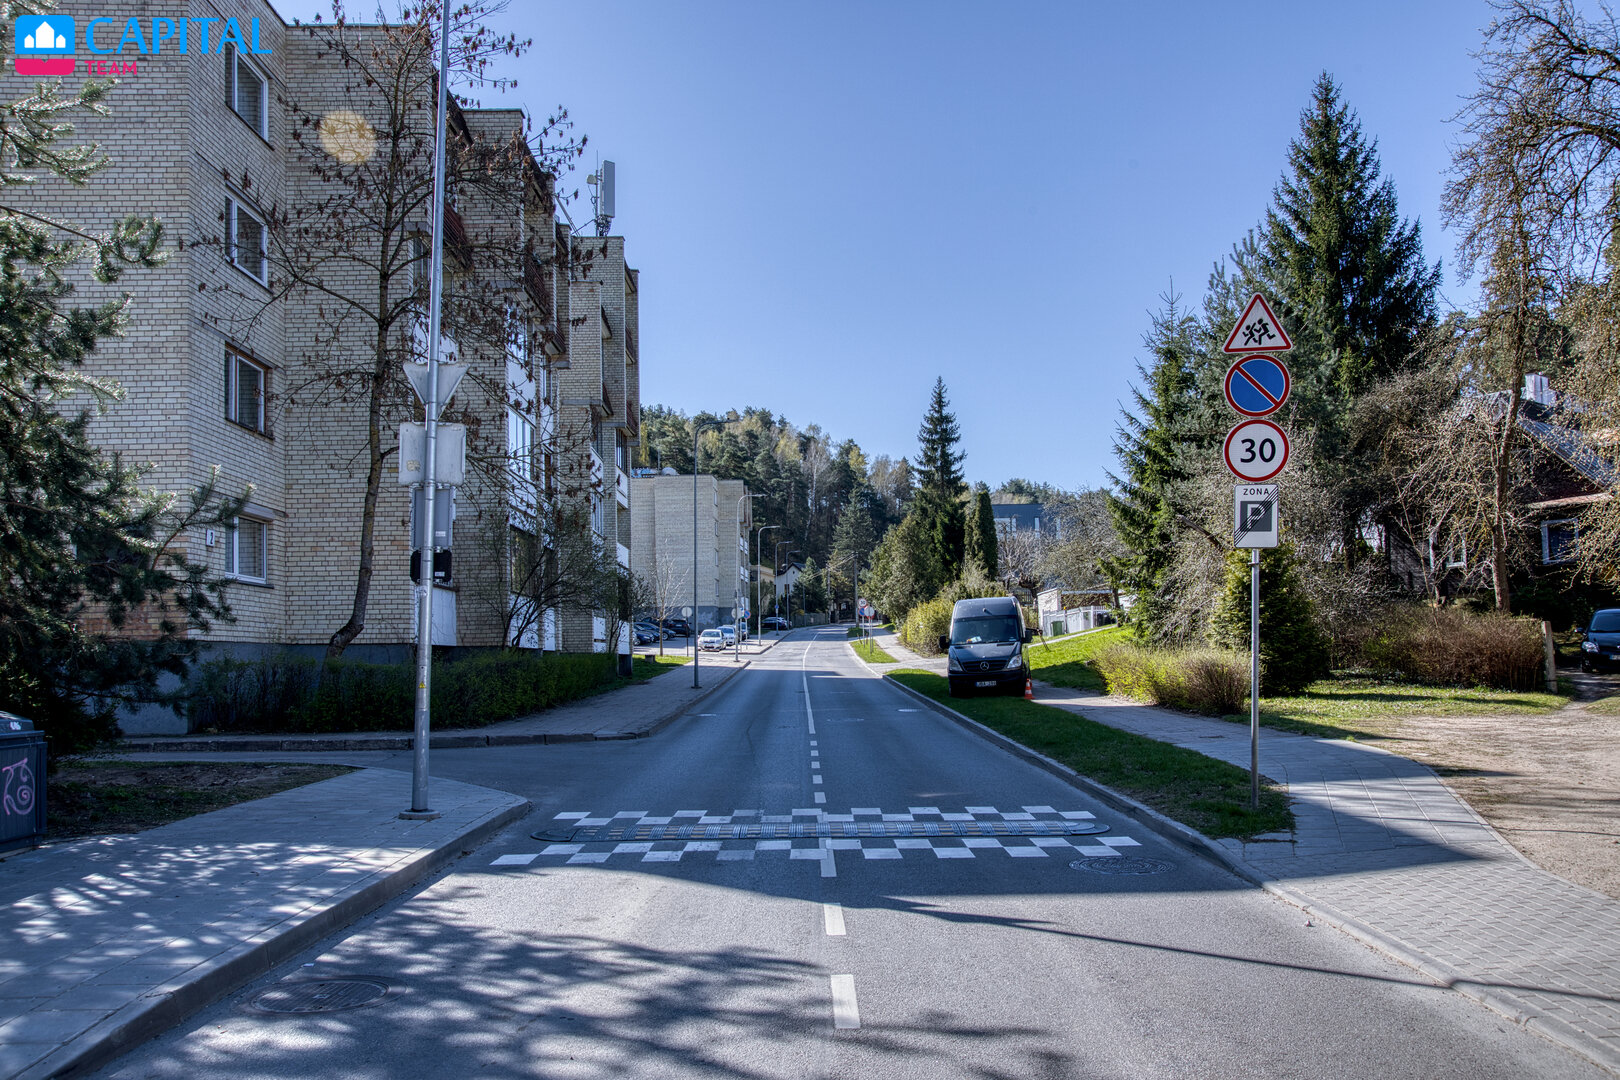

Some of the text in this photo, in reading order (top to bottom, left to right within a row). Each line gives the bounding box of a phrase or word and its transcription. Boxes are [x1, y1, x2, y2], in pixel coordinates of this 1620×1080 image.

[1240, 438, 1276, 463] 30
[1243, 488, 1270, 496] ZONA
[1246, 503, 1265, 529] P
